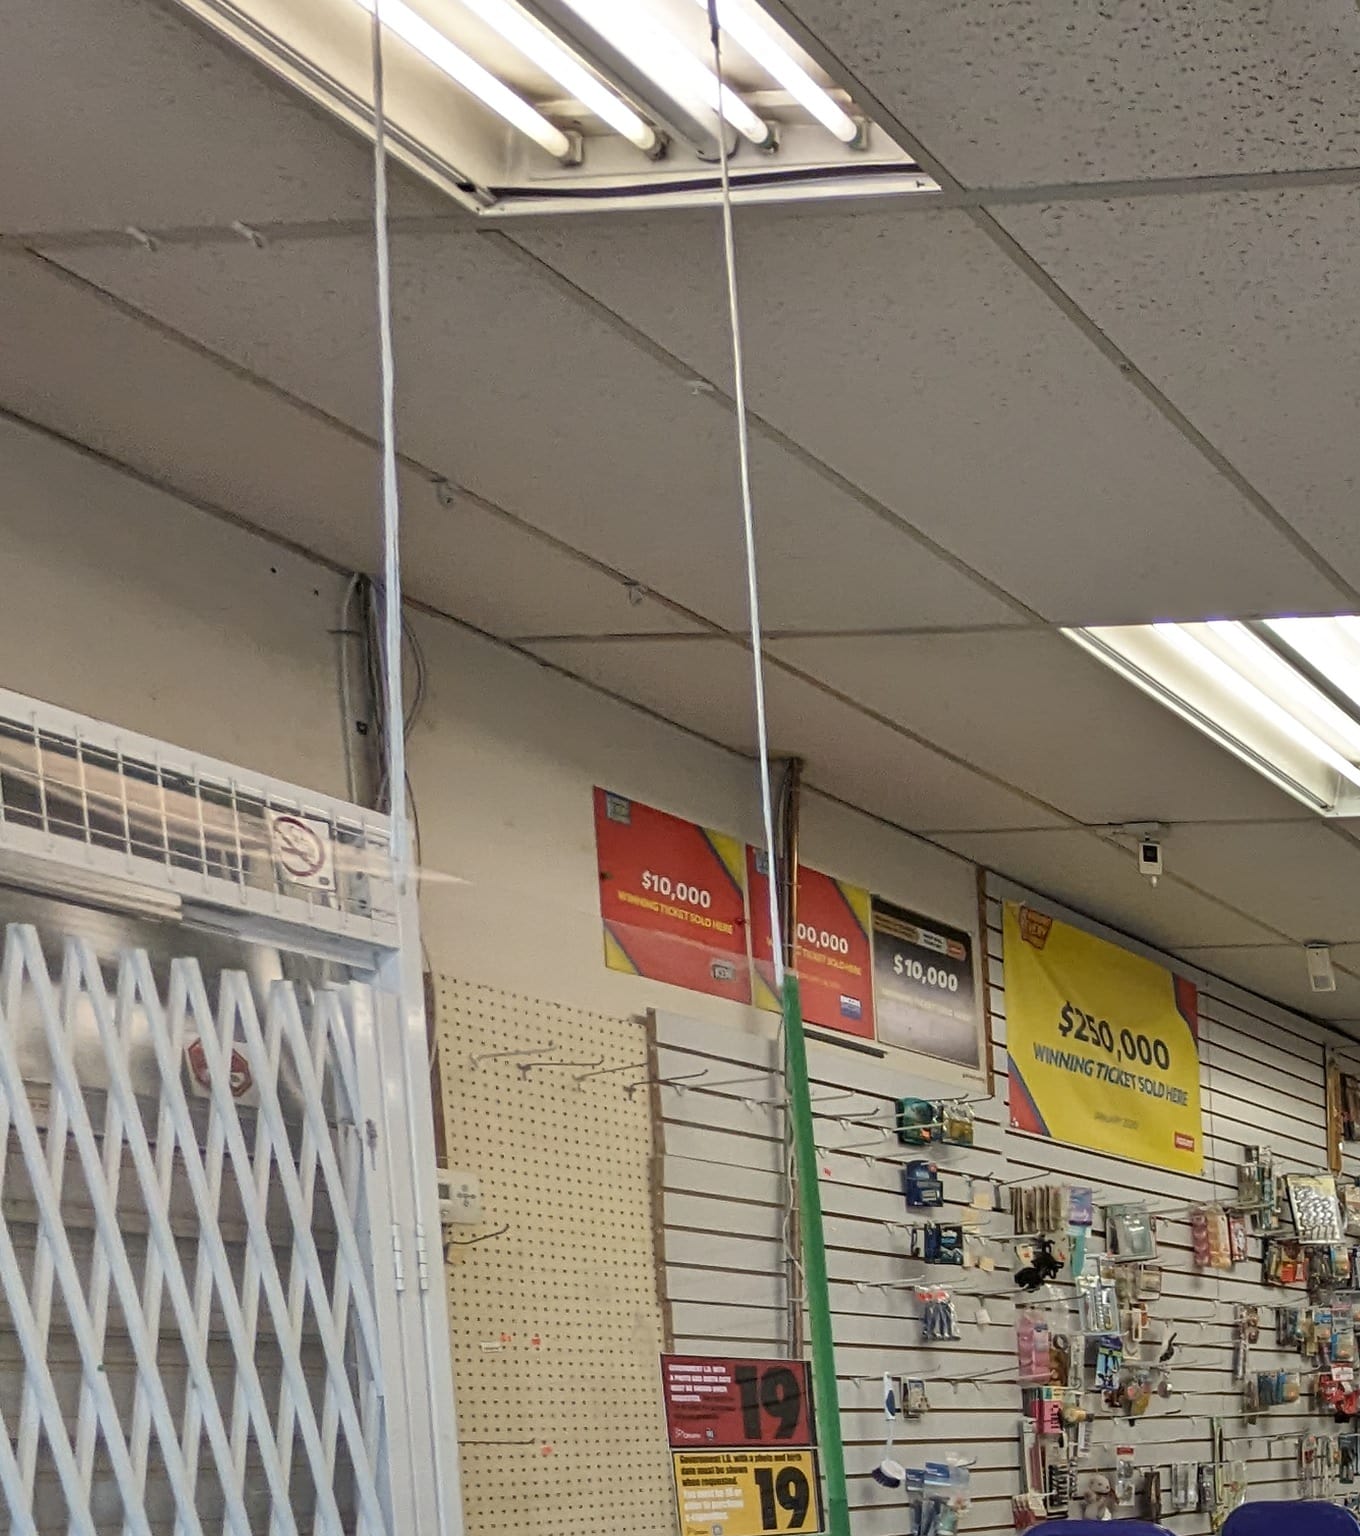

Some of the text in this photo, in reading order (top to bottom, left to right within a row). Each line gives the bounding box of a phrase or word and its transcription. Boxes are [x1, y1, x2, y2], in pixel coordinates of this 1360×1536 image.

[618, 890, 734, 935] WINNING TICKET SOLD HERE
[642, 870, 711, 909] $10,000
[894, 954, 958, 992] $10,000
[1058, 1000, 1170, 1071] $250,000
[1033, 1042, 1189, 1106] WINNING TICKET SOLD HERE
[735, 1366, 800, 1439] 19
[754, 1467, 809, 1530] 19
